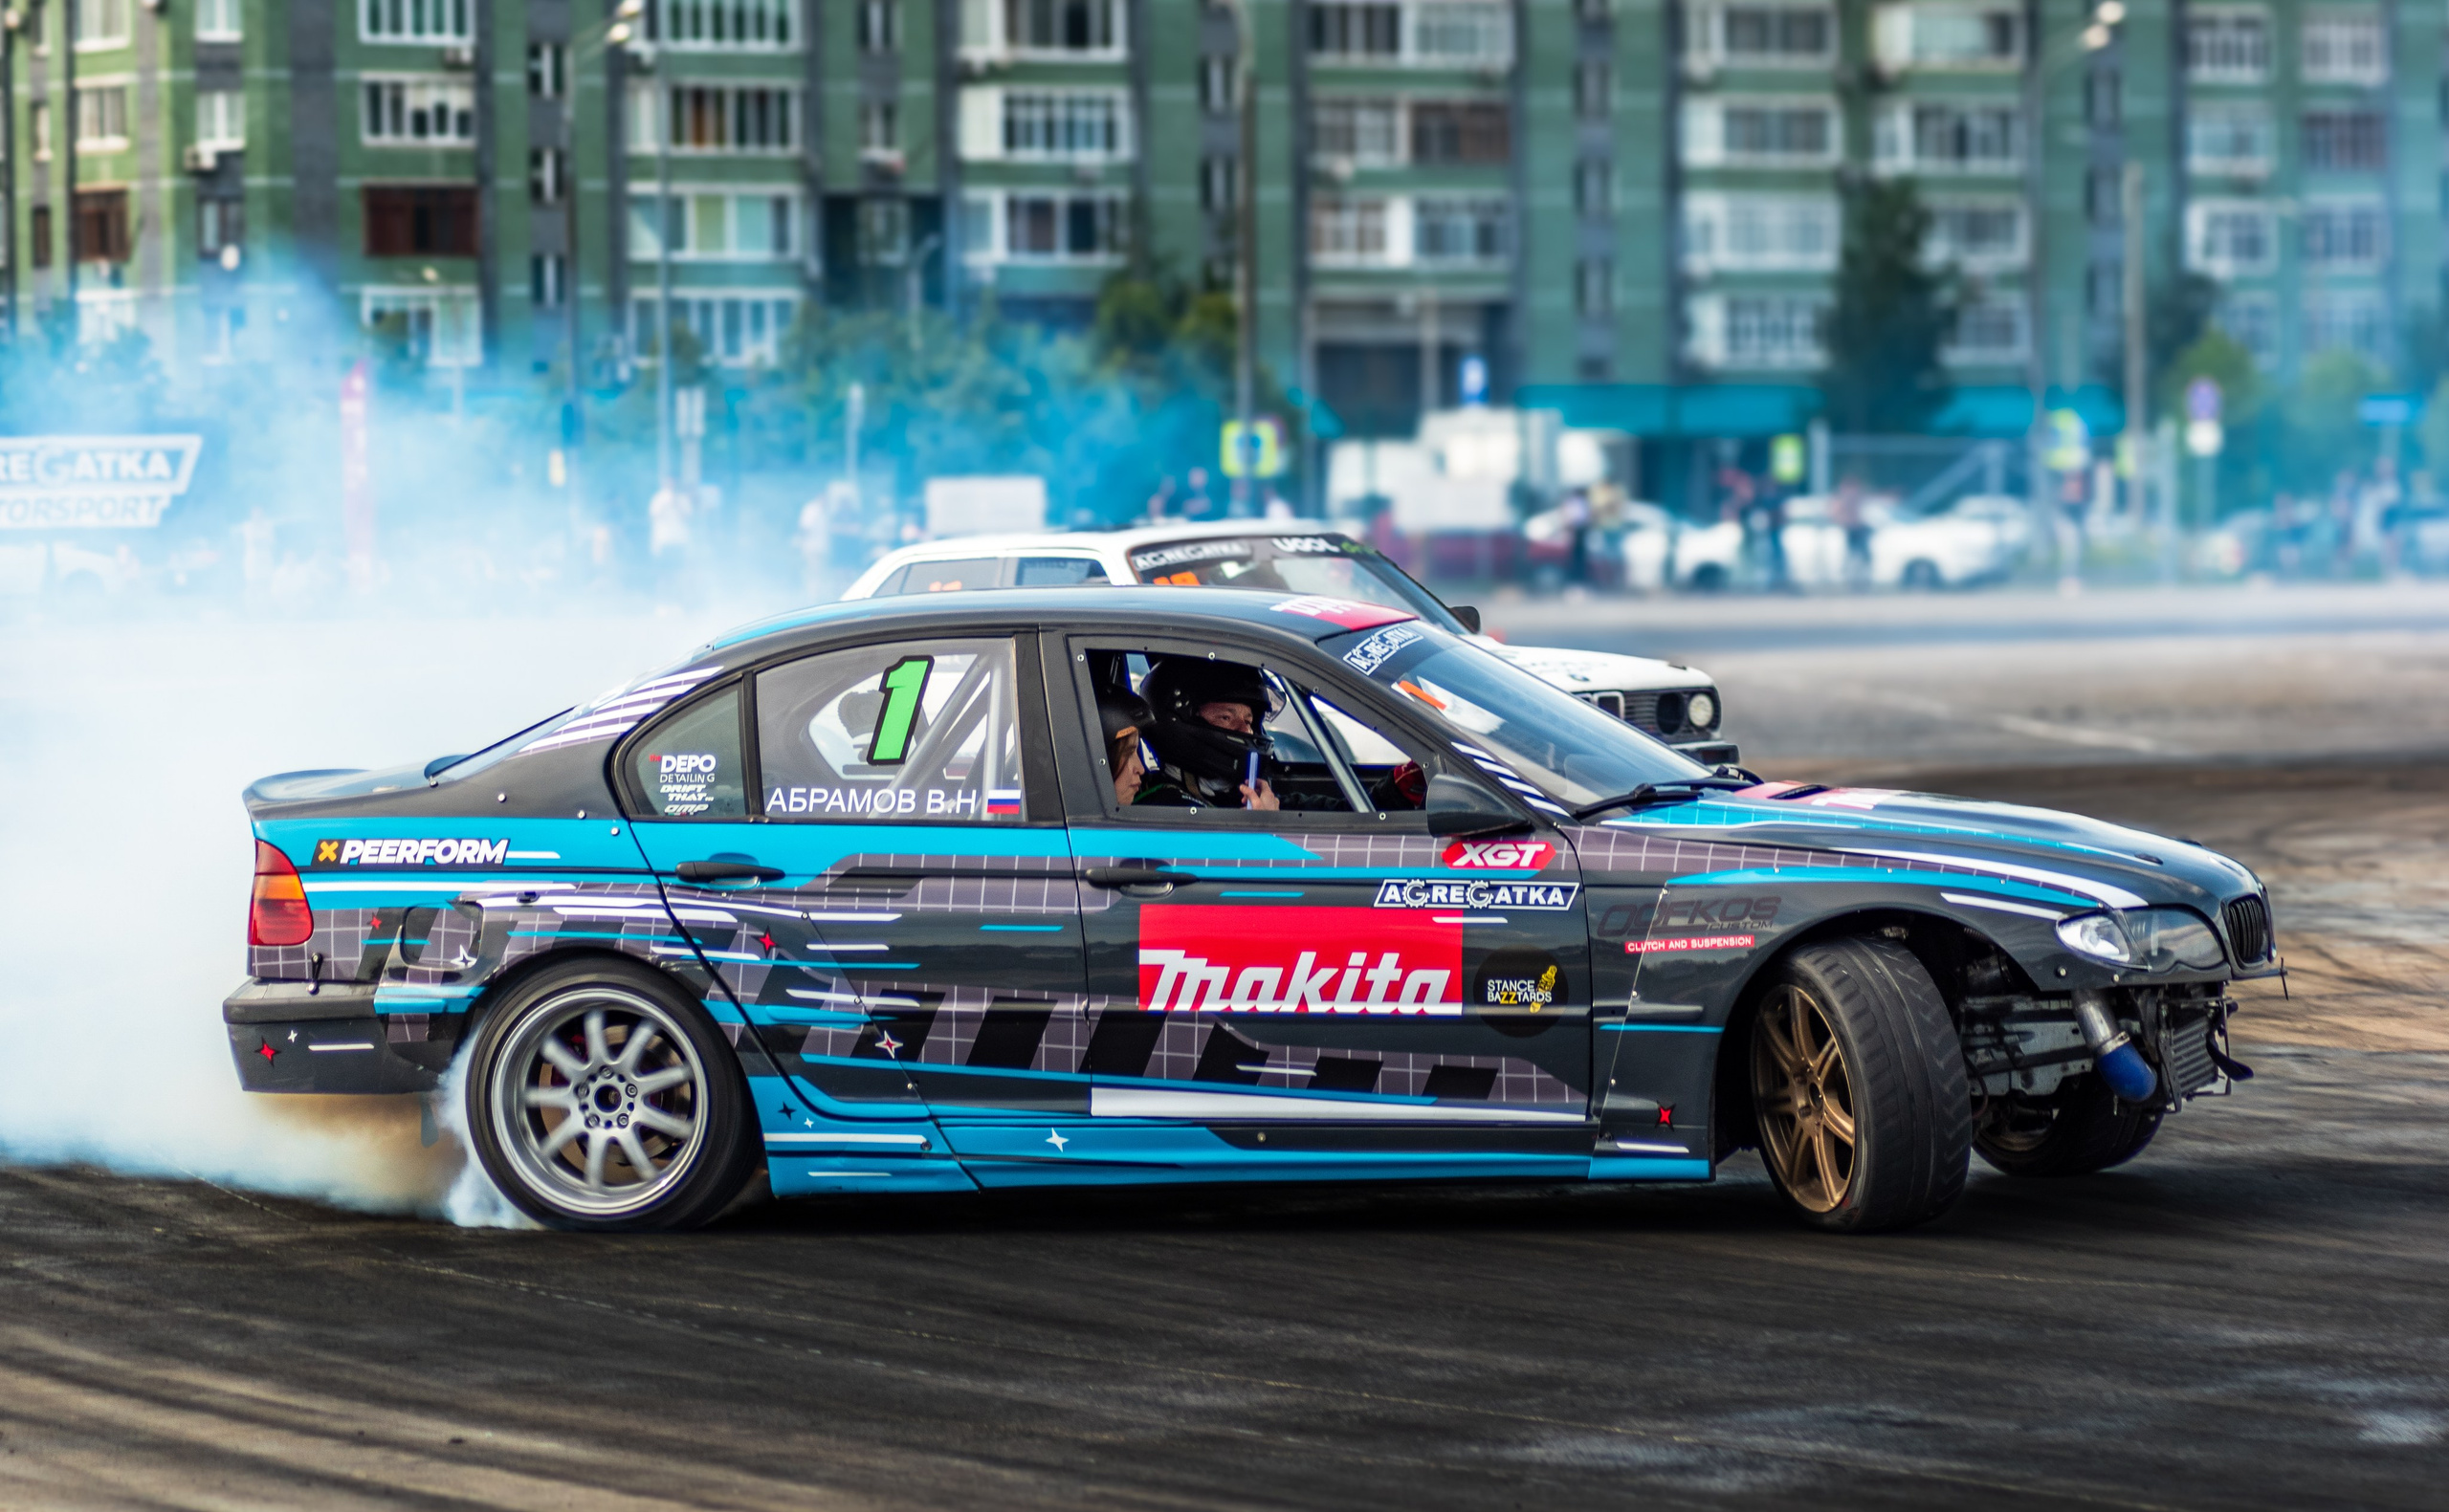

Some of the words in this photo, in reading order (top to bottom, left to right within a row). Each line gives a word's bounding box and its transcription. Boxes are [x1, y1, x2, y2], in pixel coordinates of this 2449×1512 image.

[0, 495, 161, 523] ORSPORT
[1347, 625, 1421, 672] AGREGATKA
[867, 655, 935, 765] 1
[660, 754, 717, 773] DEPO
[659, 773, 716, 783] DETAILING
[659, 784, 707, 793] DRIFT
[766, 788, 916, 813] АБРАМОВ
[340, 839, 508, 865] PEERFORM
[1452, 842, 1547, 867] XGT
[1382, 879, 1566, 909] AGREGATKA
[1627, 940, 1666, 953] CLUTCH
[1668, 939, 1688, 950] AND
[1690, 935, 1752, 949] SUSPENSION
[1487, 979, 1535, 992] STANCE
[1487, 992, 1553, 1004] BAZZTARDS
